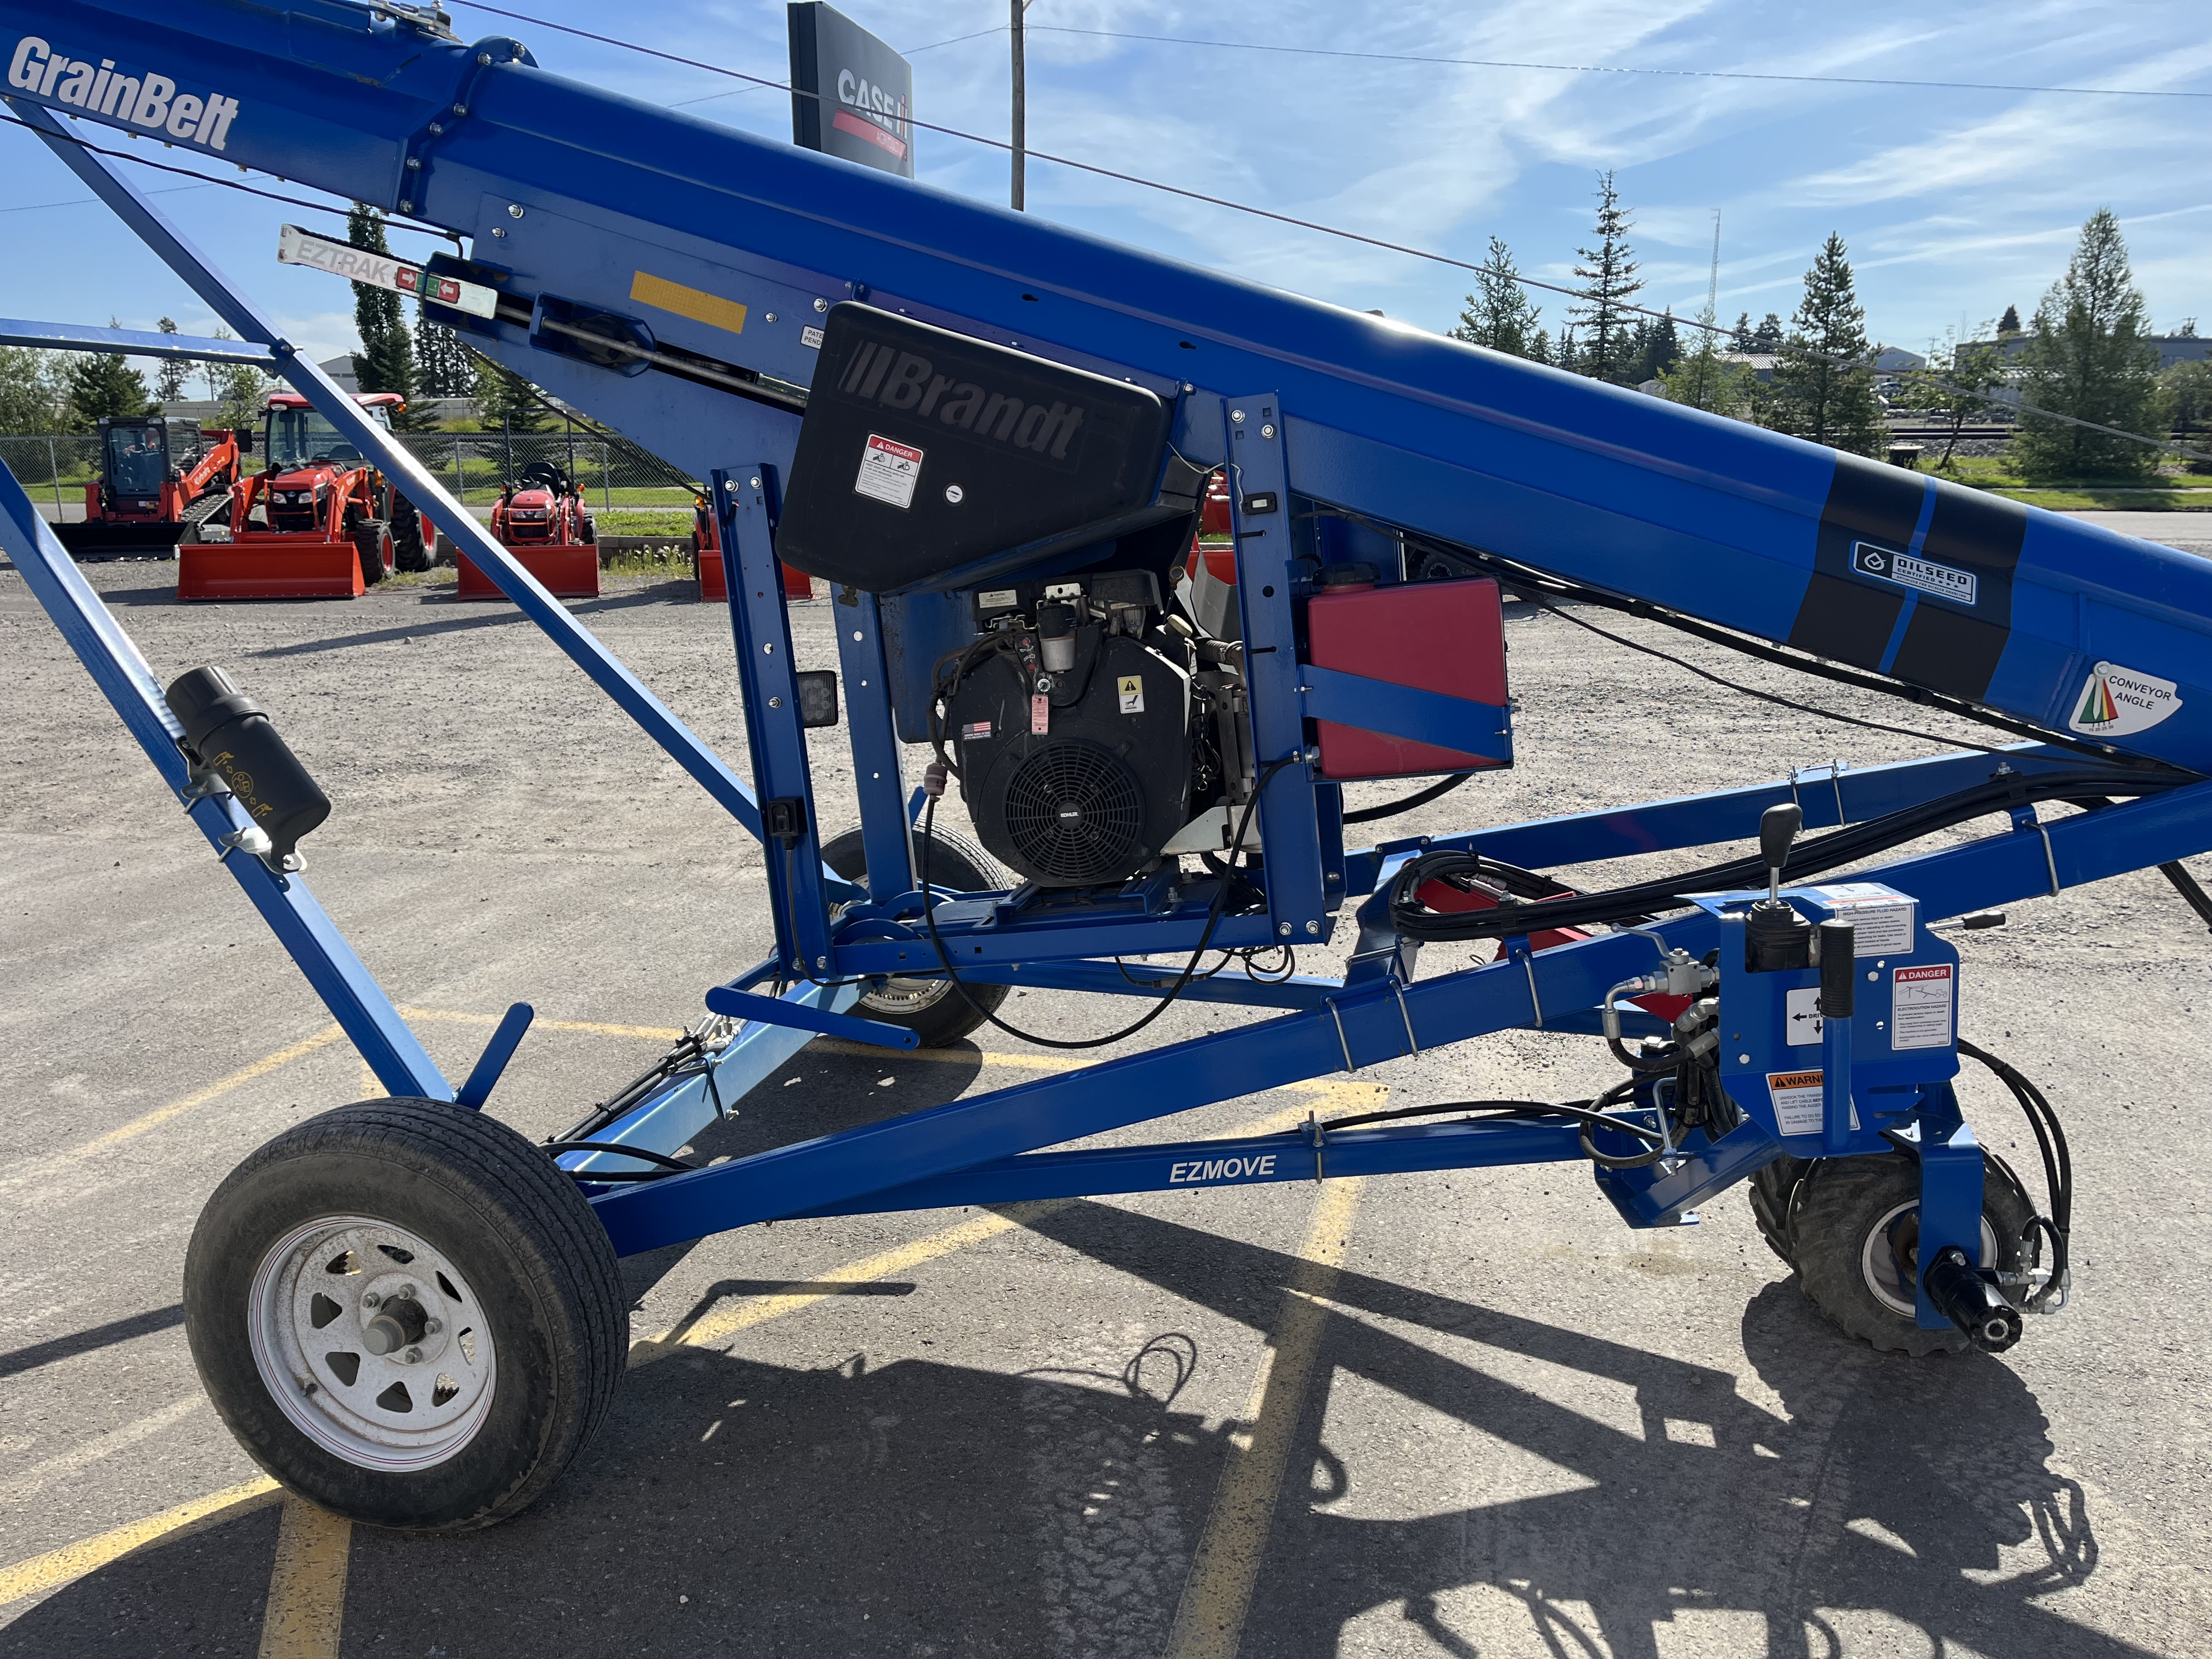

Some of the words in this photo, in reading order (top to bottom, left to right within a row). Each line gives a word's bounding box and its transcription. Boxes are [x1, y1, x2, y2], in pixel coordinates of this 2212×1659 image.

[8, 37, 239, 151] GrainBelt
[838, 69, 894, 129] CASE
[296, 241, 391, 284] EZTRAK
[804, 336, 821, 346] PEND
[808, 330, 823, 339] PATE
[884, 351, 1085, 462] Brandt
[885, 443, 913, 458] DANGER
[1897, 568, 1935, 582] CERTIFIED
[1898, 558, 1967, 585] OILSEED
[2109, 676, 2171, 701] CONVEYOR
[2114, 692, 2155, 710] ANGLE
[1909, 969, 1946, 979] DANGER
[1785, 1075, 1823, 1086] WARNI
[1169, 1155, 1277, 1183] EZMOVE
